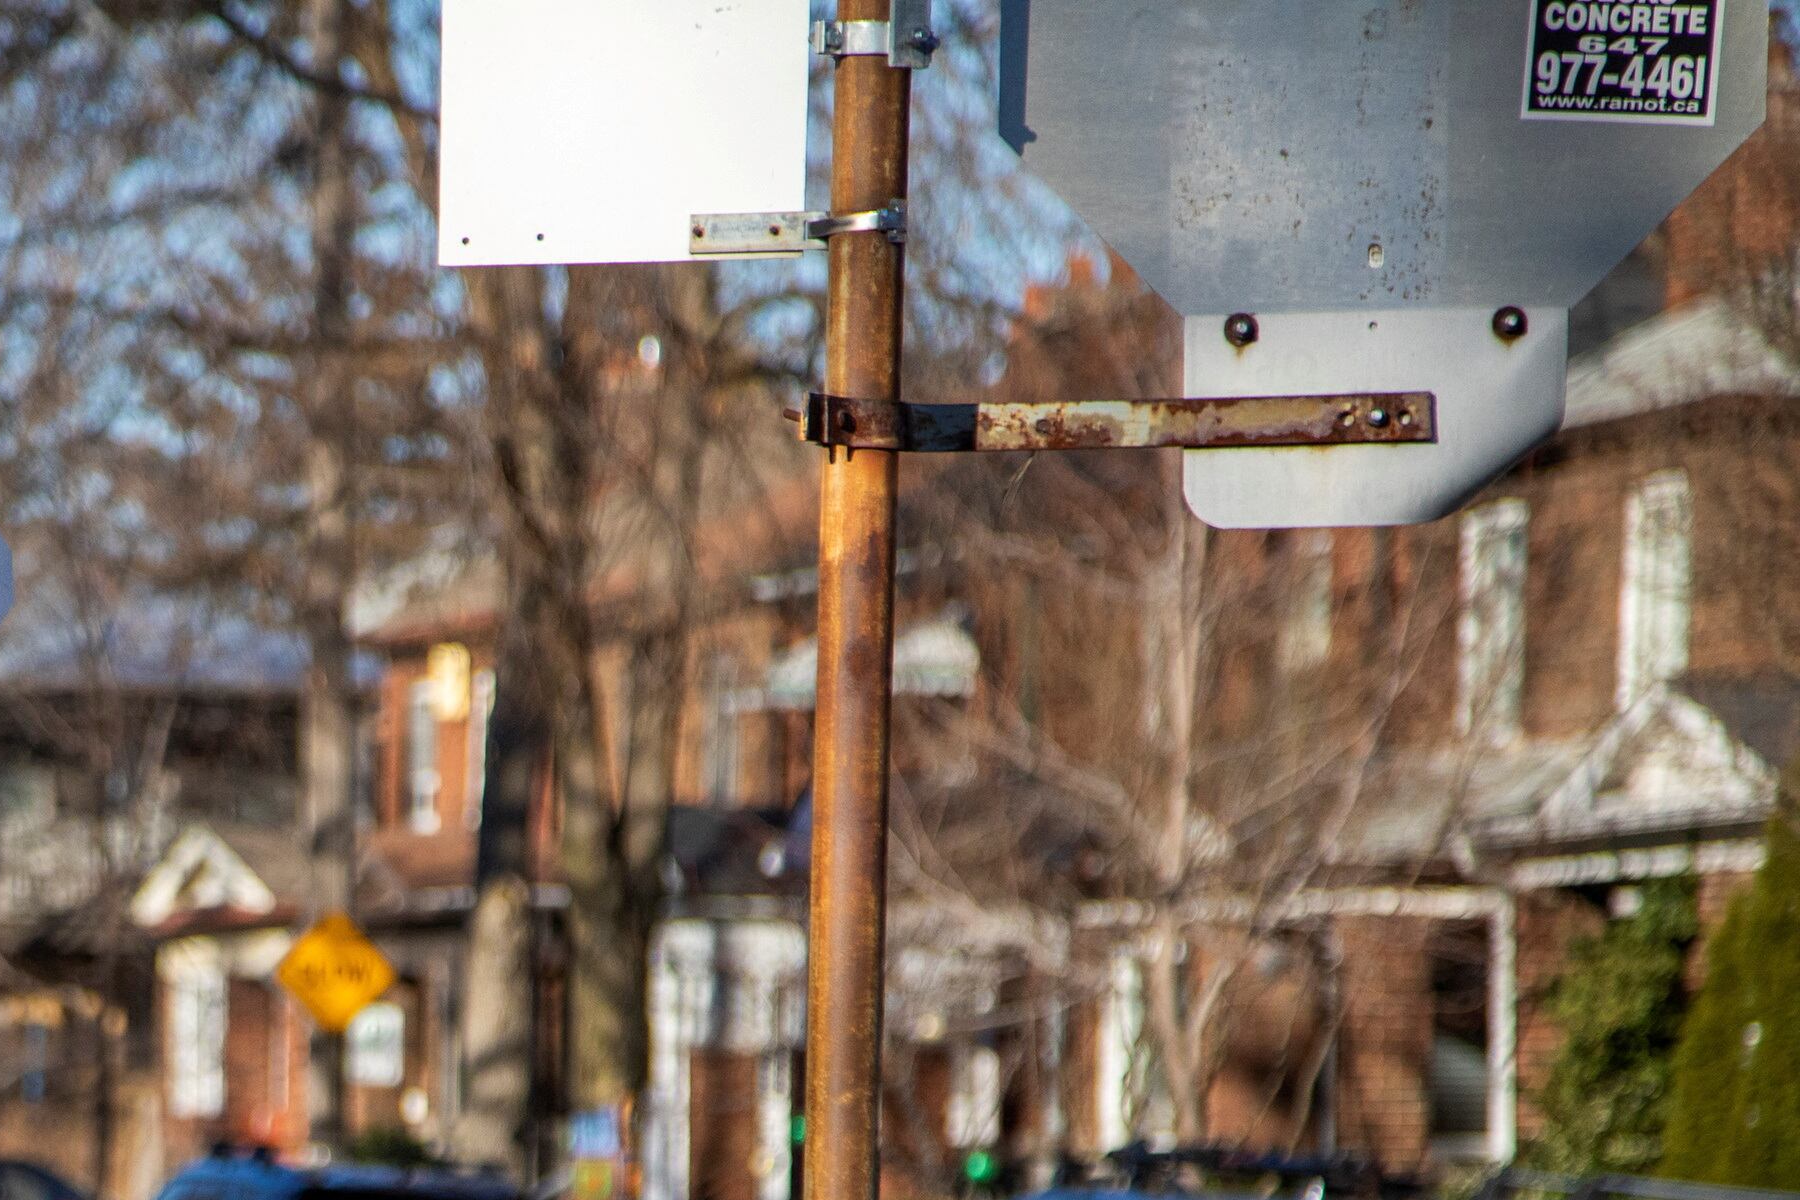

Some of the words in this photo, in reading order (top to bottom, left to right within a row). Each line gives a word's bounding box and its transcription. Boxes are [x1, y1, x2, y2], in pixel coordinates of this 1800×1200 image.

[1546, 3, 1707, 34] CONCRETE
[1578, 36, 1669, 55] 647
[1536, 50, 1706, 99] 977-4461
[1538, 95, 1700, 114] www.ramot.ca
